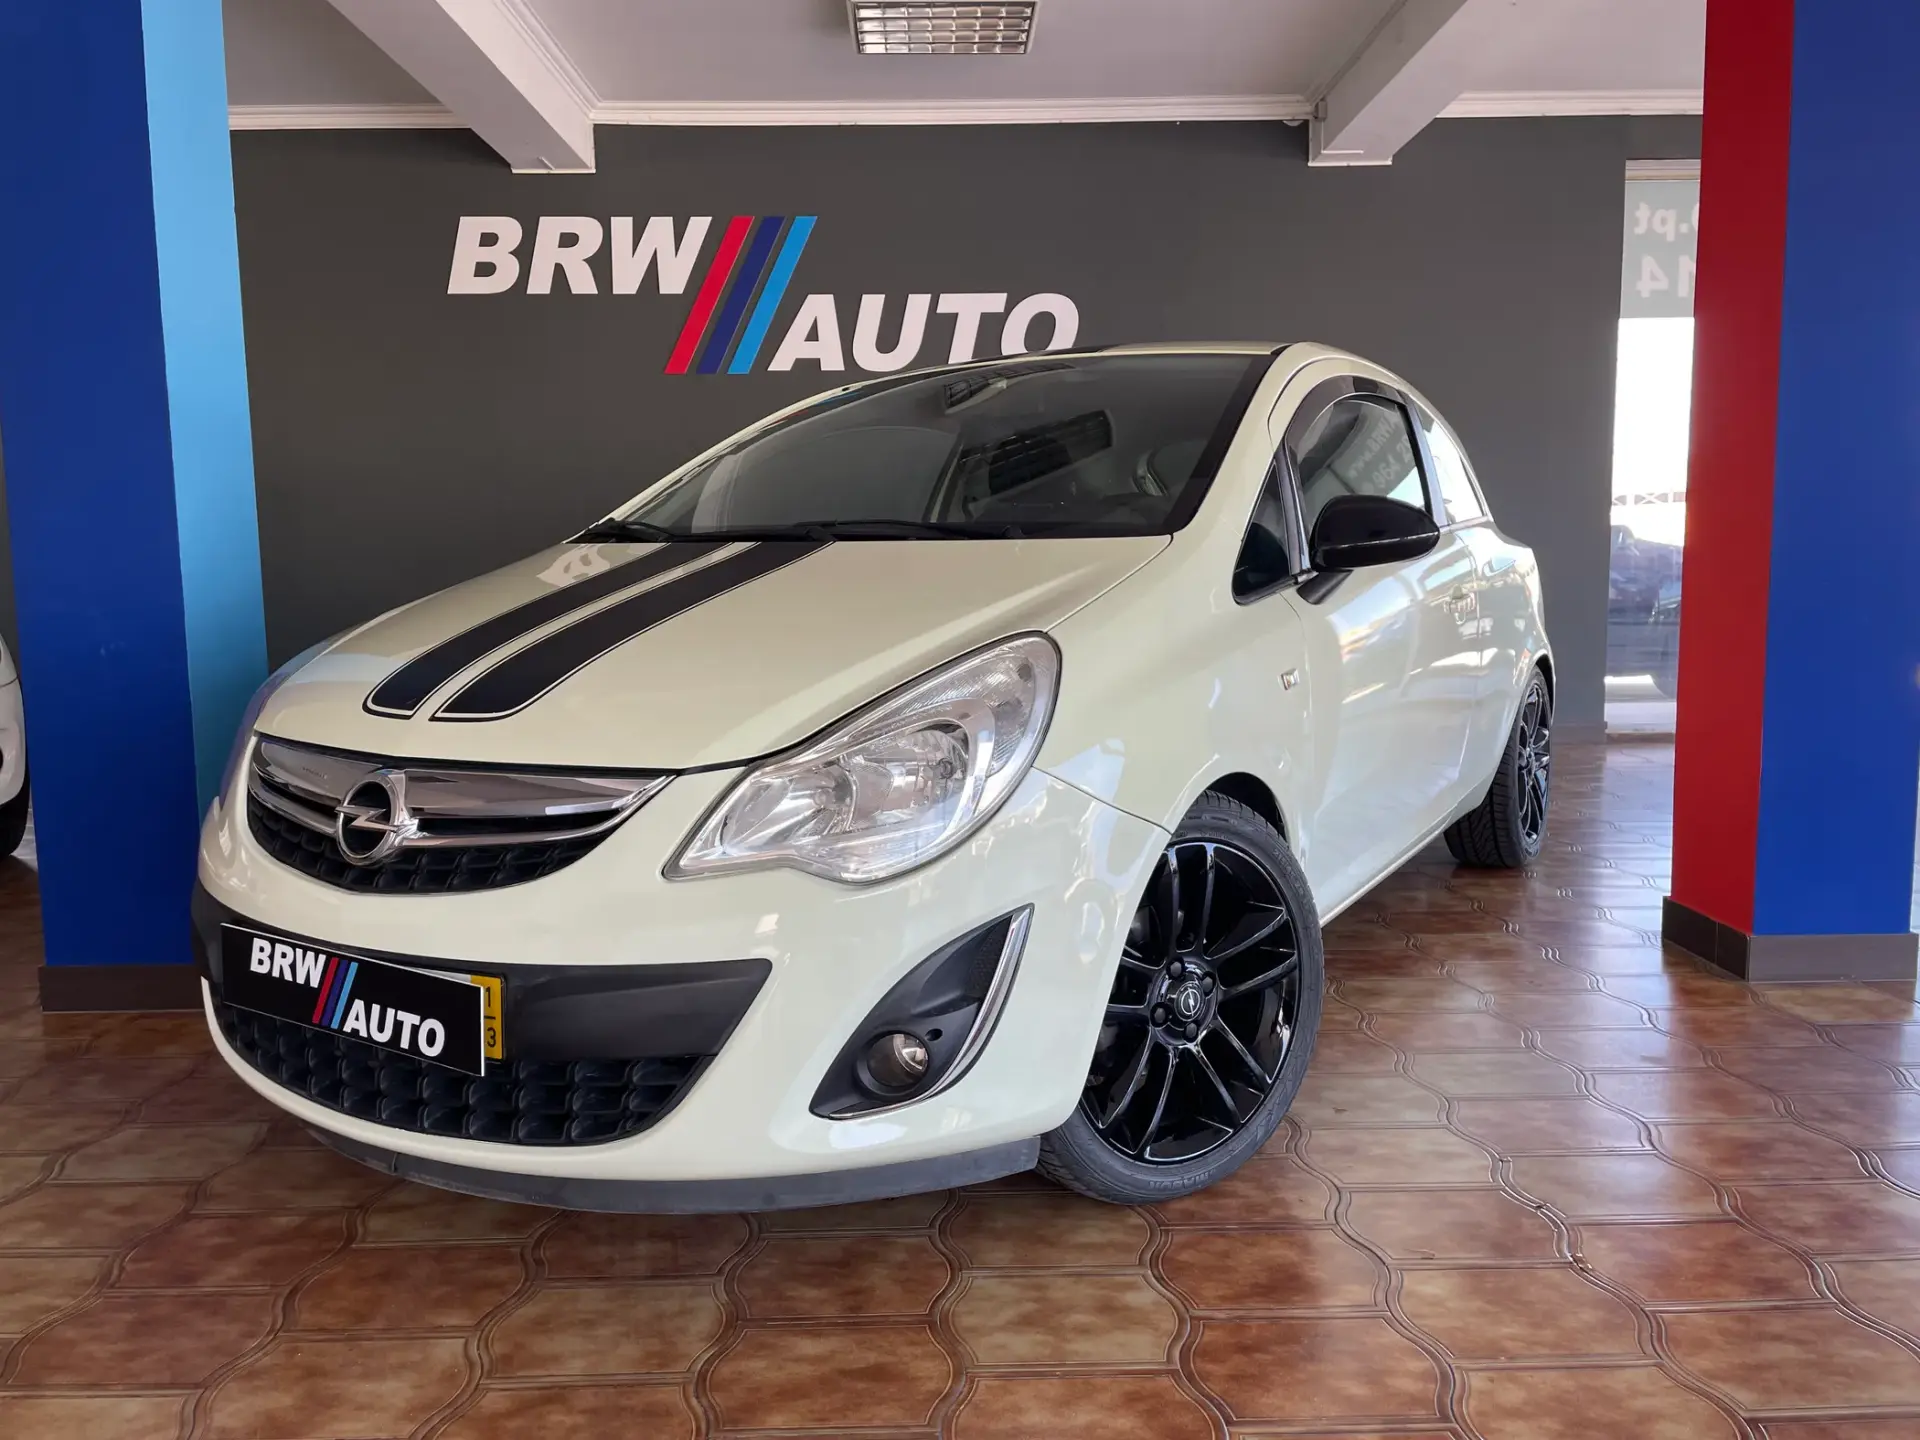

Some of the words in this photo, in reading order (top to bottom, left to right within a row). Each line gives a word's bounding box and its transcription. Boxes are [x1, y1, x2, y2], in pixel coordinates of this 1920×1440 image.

[447, 216, 713, 295] BRW
[767, 293, 1080, 372] AUTO
[250, 937, 327, 989] BRW
[342, 998, 446, 1058] AUTO
